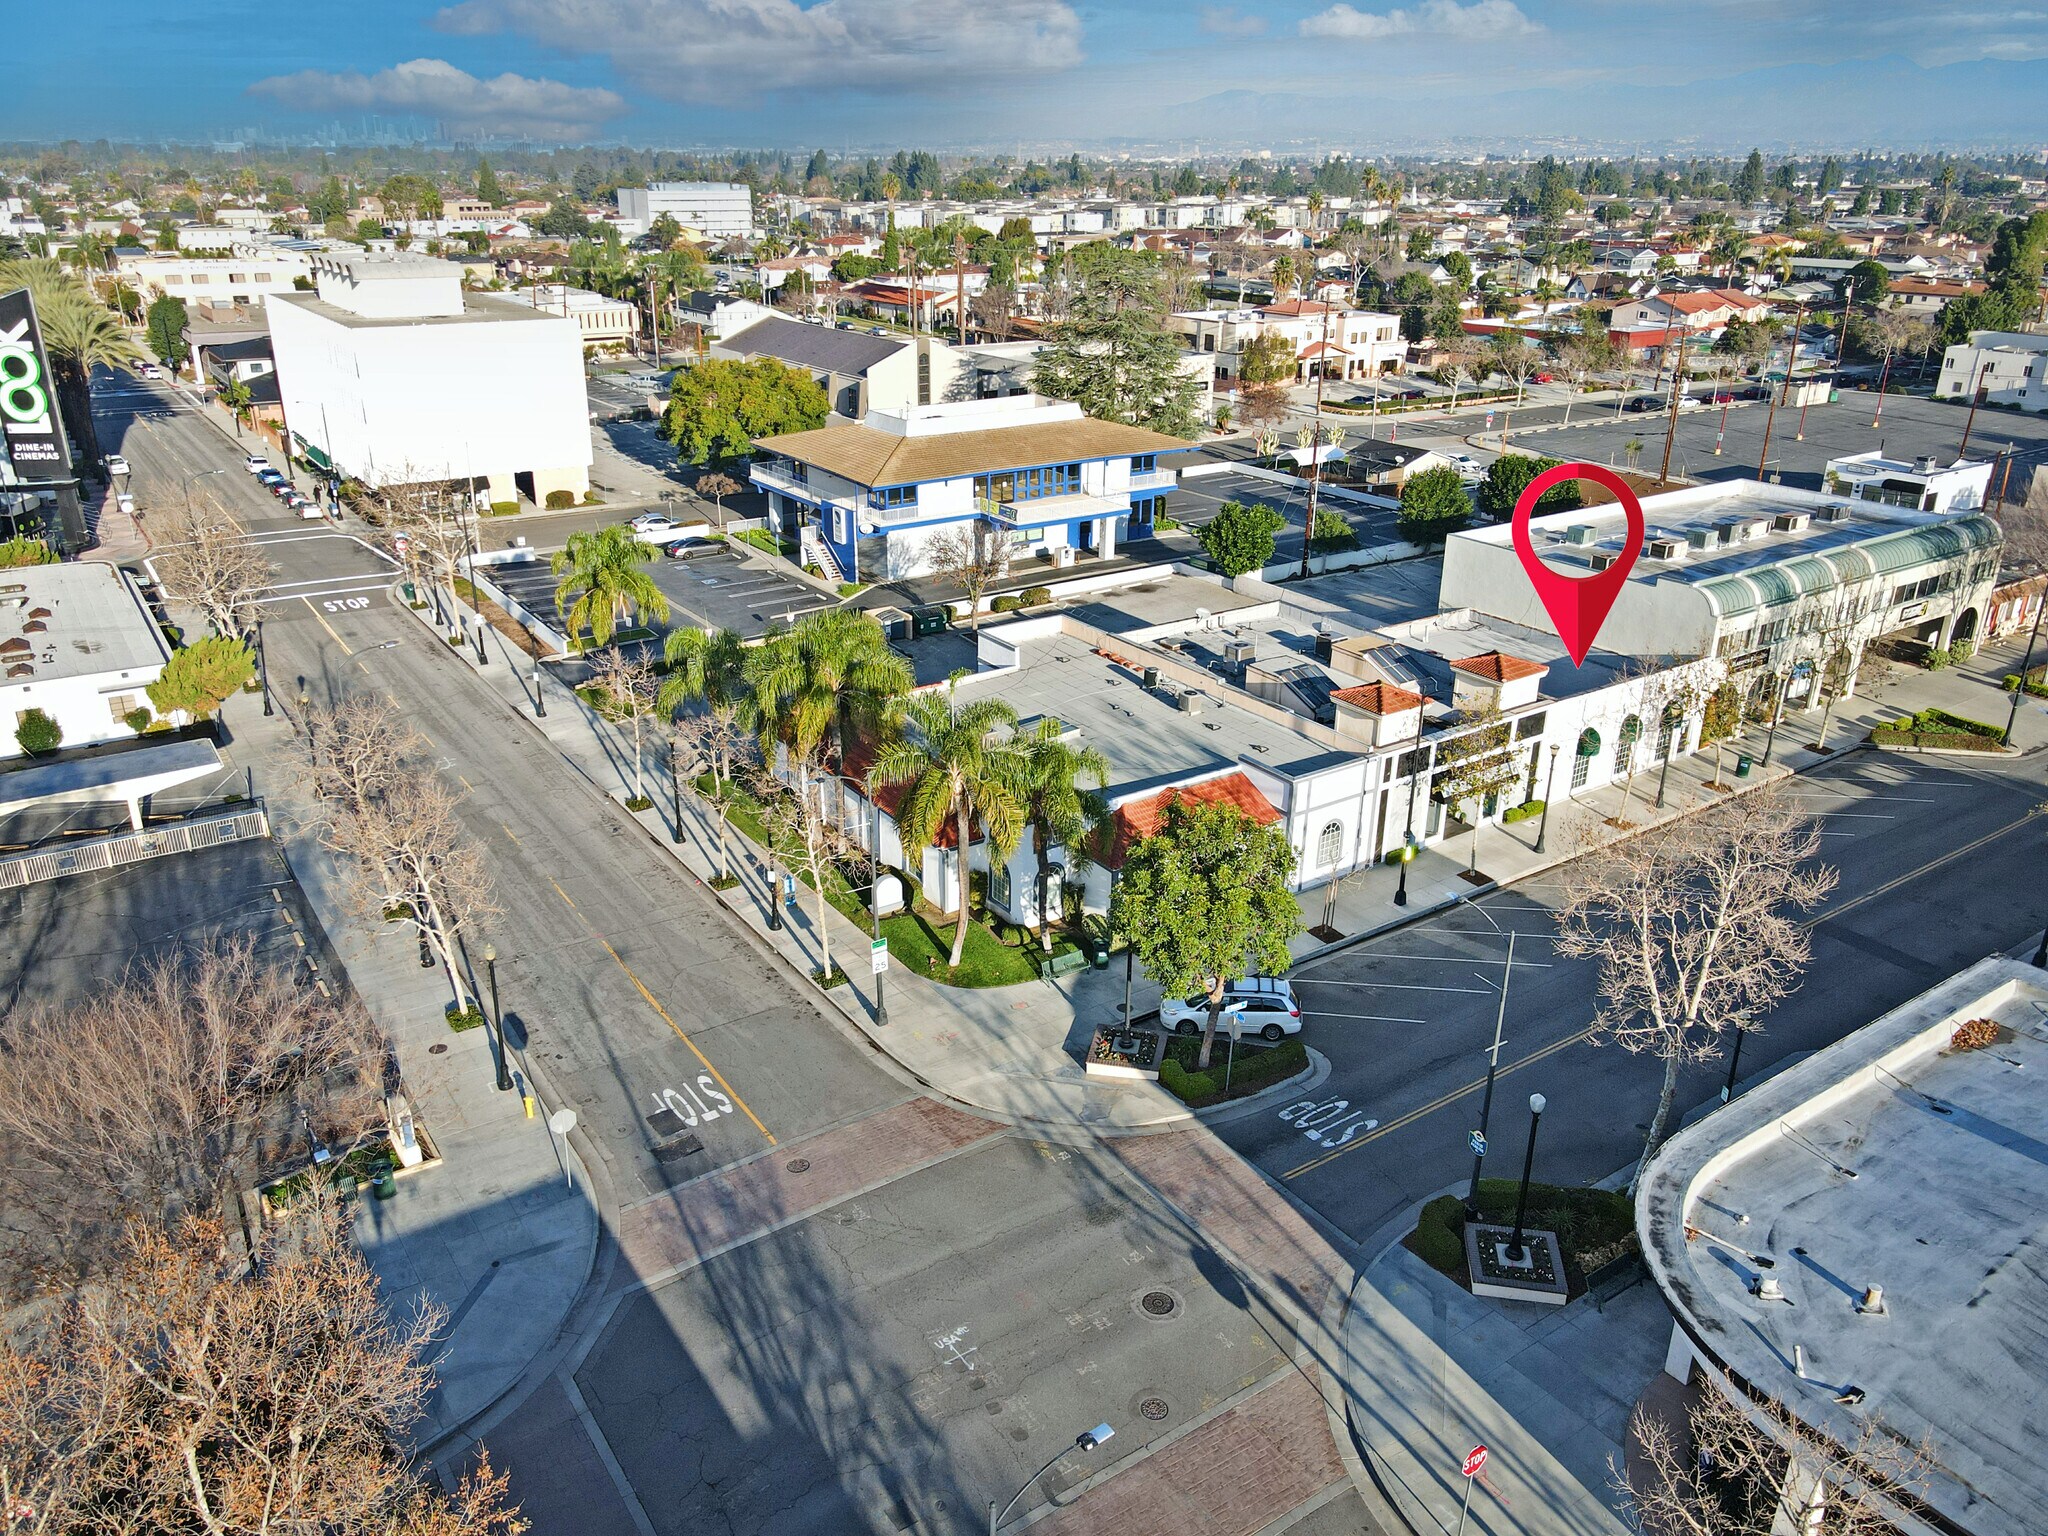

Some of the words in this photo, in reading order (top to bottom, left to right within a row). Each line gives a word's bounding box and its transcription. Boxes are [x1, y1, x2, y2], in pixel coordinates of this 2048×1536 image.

[15, 443, 54, 451] DINE-IN
[13, 452, 60, 460] CINEMAS
[323, 597, 370, 612] STOP
[875, 961, 887, 971] 25
[1278, 1095, 1379, 1148] STOP
[934, 1335, 962, 1348] USA
[1464, 1450, 1487, 1470] STOP
